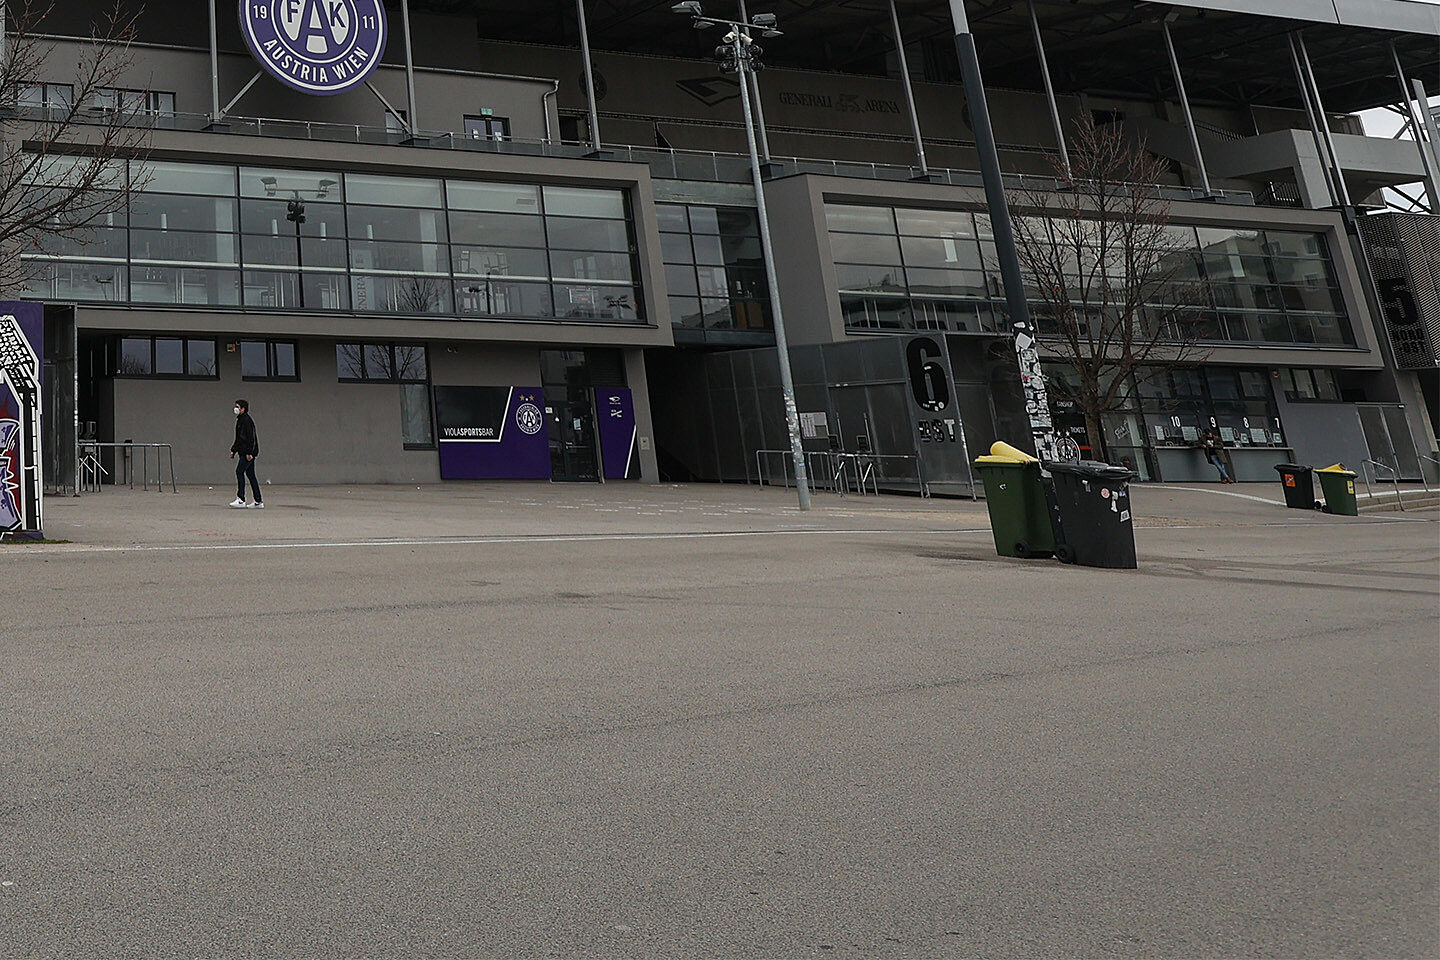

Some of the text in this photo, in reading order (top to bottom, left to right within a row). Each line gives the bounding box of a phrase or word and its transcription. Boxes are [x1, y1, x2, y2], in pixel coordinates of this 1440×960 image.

[253, 4, 268, 20] 19
[362, 15, 375, 30] 11
[263, 38, 370, 83] AUSTRIA WIEN
[779, 91, 901, 114] GENERALI ARENA
[1378, 277, 1419, 325] 5
[906, 337, 949, 412] 6
[443, 427, 495, 437] VIOLASPORTSBAR
[1170, 415, 1181, 428] 10
[1210, 416, 1217, 428] 9
[1243, 416, 1250, 429] 8
